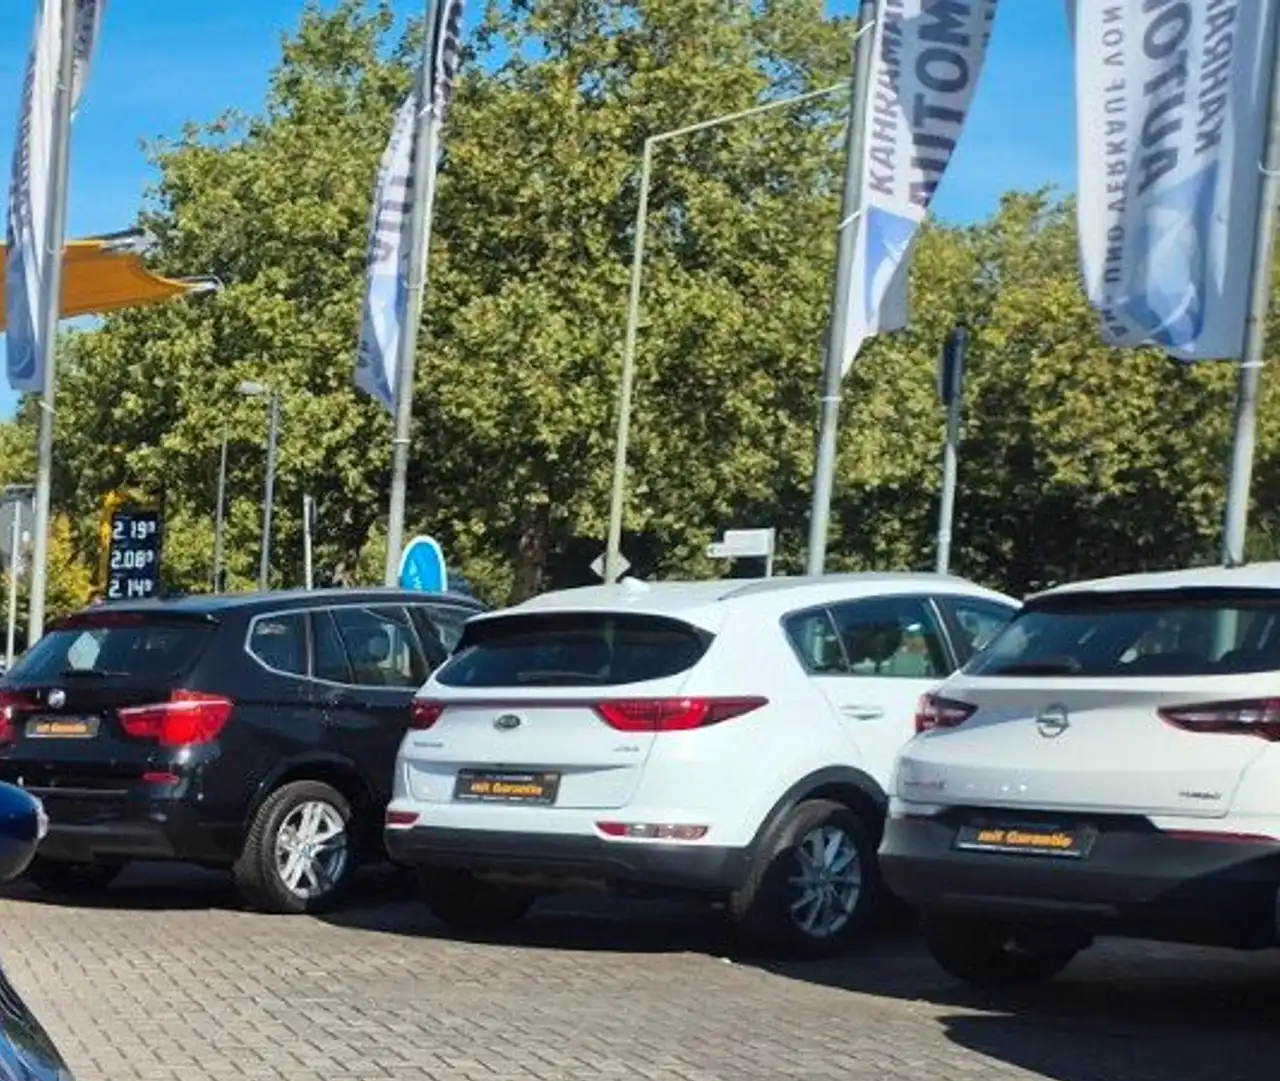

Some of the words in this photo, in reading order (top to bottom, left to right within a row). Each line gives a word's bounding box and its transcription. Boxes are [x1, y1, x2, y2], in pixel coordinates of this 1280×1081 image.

[493, 780, 542, 796] Garantie
[978, 828, 1007, 843] mit
[1007, 827, 1073, 848] Garantie
